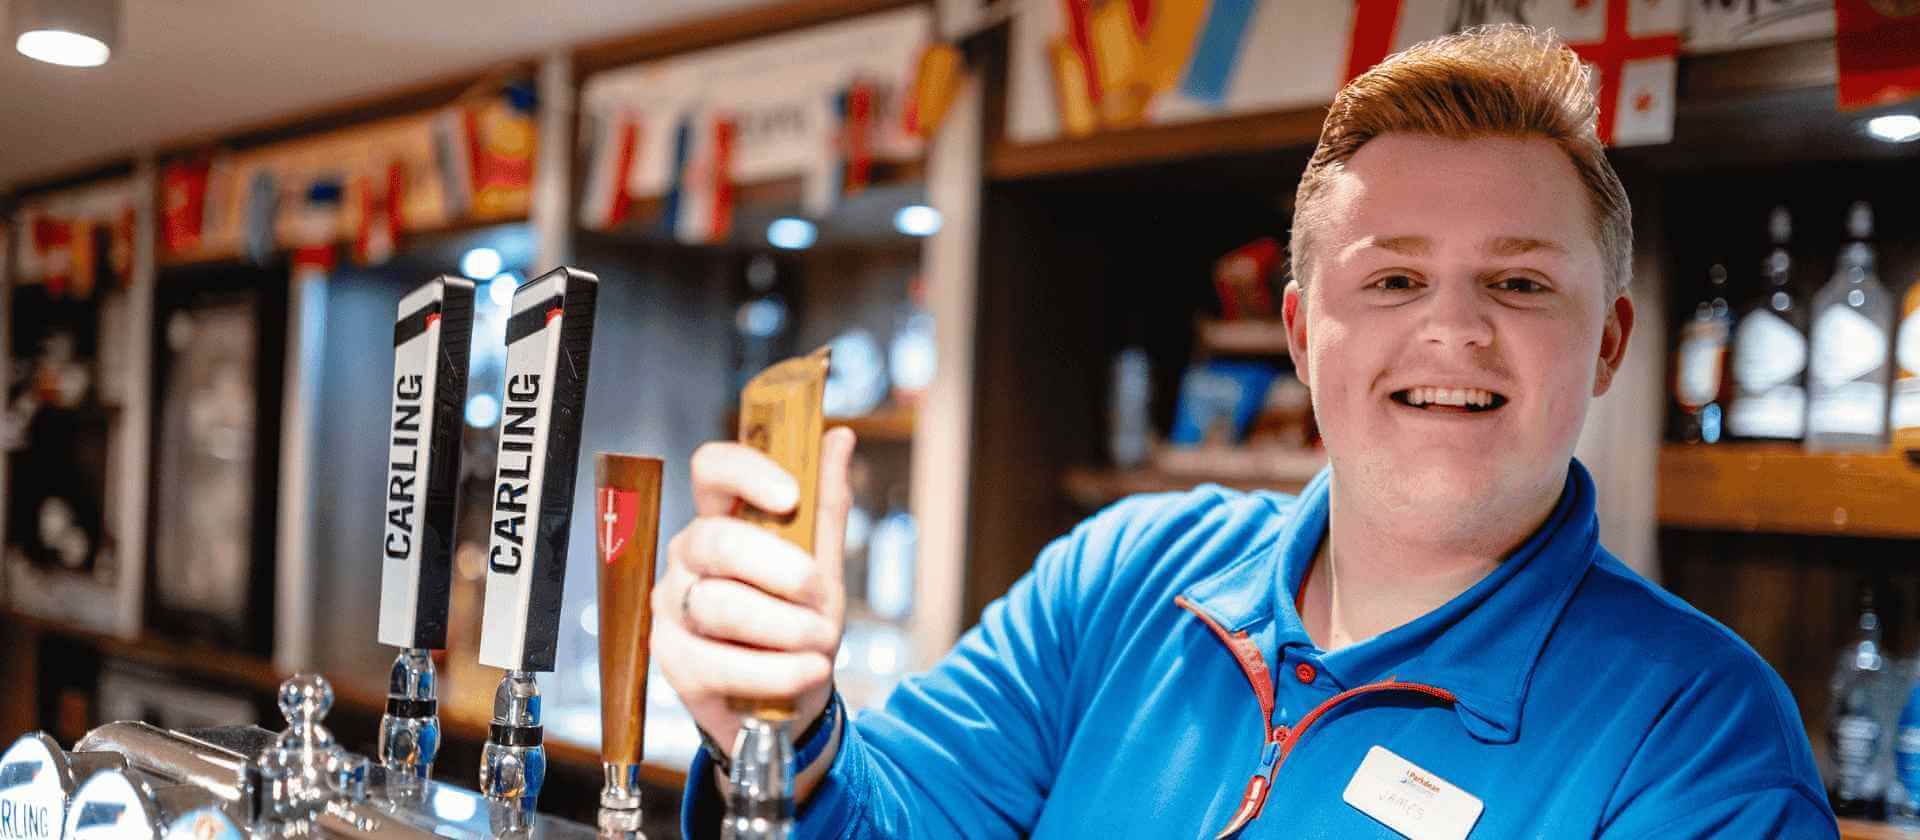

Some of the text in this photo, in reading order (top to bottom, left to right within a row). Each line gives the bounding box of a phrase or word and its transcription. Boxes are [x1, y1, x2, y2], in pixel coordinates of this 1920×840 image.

[385, 374, 423, 560] CARLING
[490, 374, 540, 575] CARLING
[0, 798, 49, 839] RLING
